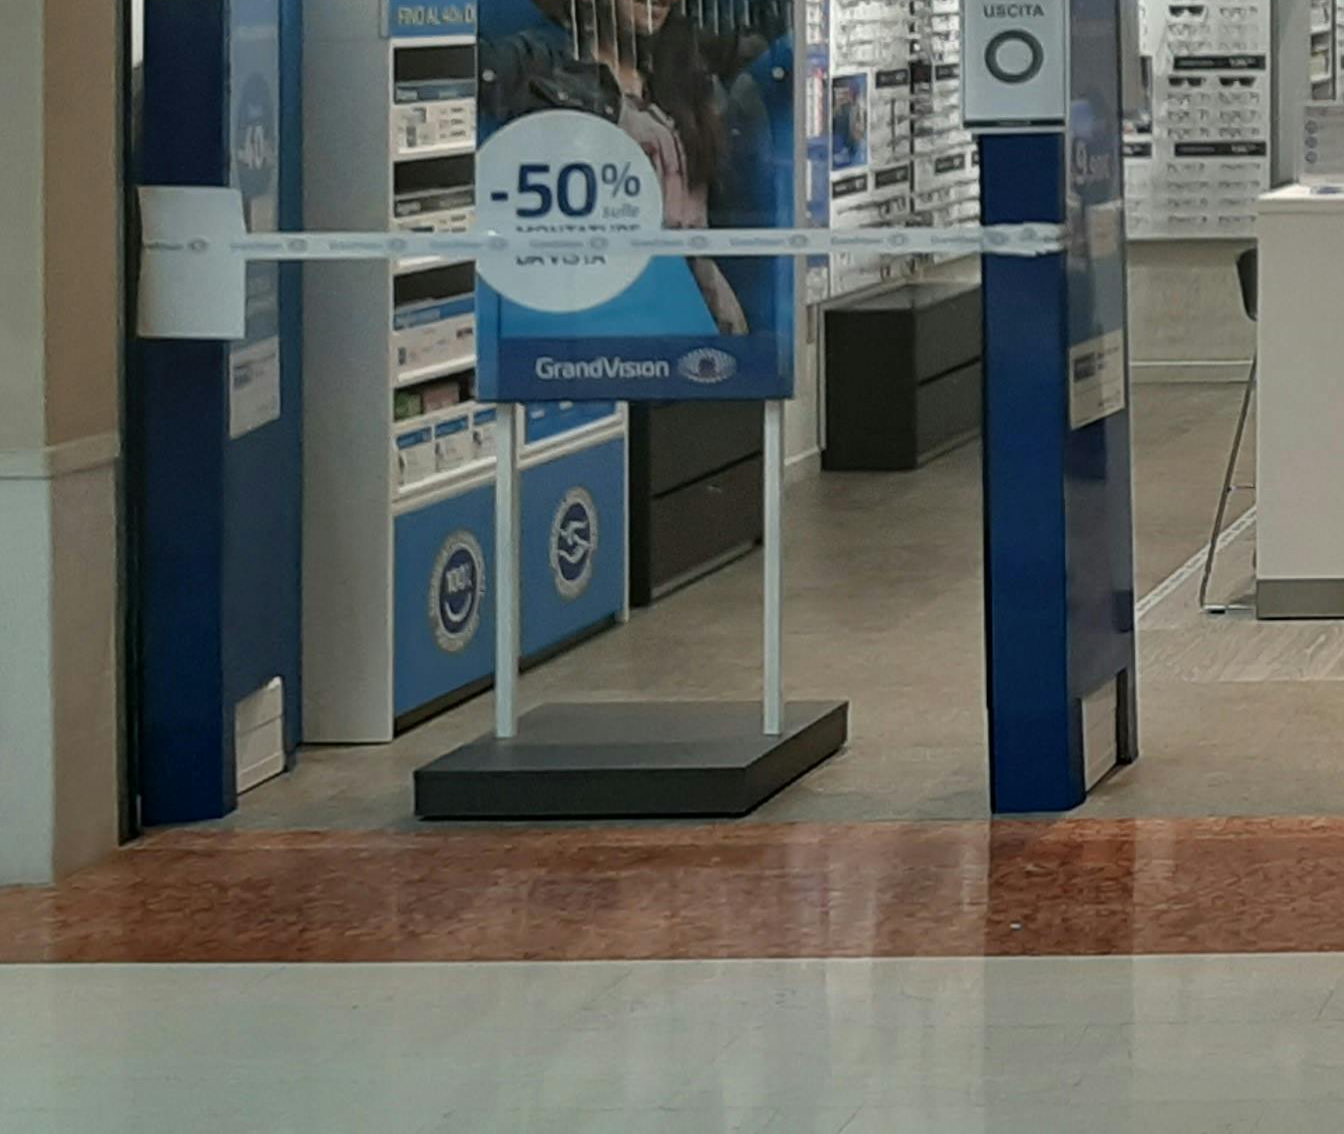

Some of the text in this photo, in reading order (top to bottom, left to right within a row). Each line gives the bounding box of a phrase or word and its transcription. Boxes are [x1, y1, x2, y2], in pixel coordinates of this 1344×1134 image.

[984, 4, 1045, 18] USCITA
[491, 161, 641, 218] -50%
[535, 357, 669, 379] GrandVision
